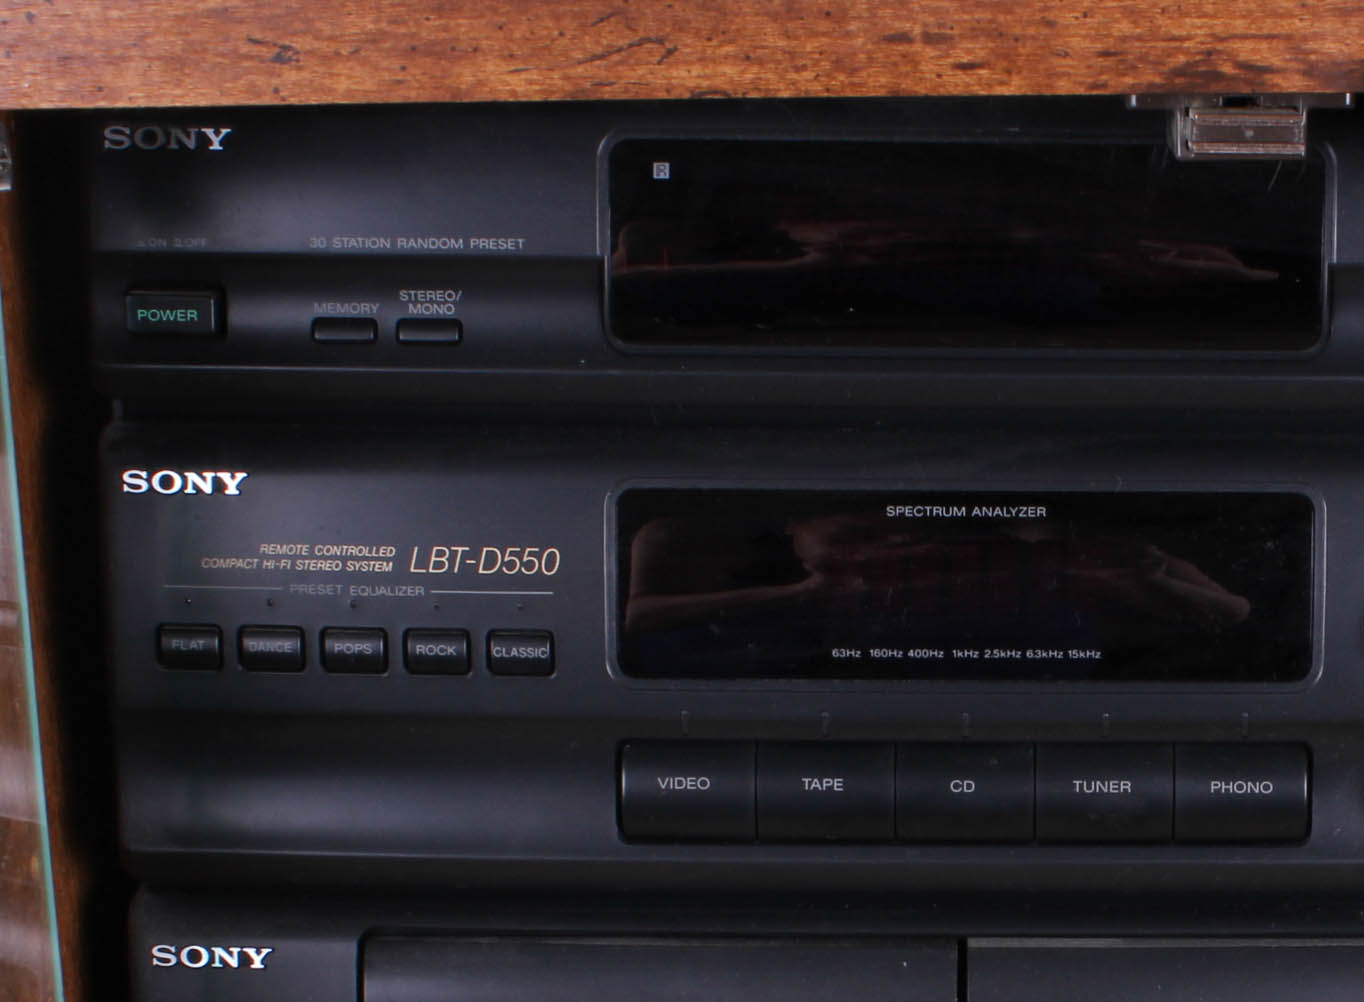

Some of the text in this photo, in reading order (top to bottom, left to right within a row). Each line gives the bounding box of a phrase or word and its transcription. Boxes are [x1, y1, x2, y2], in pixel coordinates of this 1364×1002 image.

[105, 127, 231, 150] SONY
[310, 237, 524, 249] 30 STATION RANDOM PRESET
[400, 290, 462, 301] STEREO/
[314, 303, 379, 314] MEMORY
[409, 303, 455, 315] MONO
[138, 309, 197, 321] POWER
[123, 470, 247, 494] SONY
[887, 506, 1046, 517] SPECTRUM ANALYZER
[260, 544, 395, 557] REMOTE CONTROLLED
[202, 558, 392, 572] COMPACT HI-FI STEREO SYSTEM
[410, 547, 560, 575] LBT-D550
[290, 584, 424, 596] PRESET EQUALIZER
[249, 641, 292, 652] DANCE
[334, 643, 372, 654] POPS
[416, 645, 456, 655] ROCK
[493, 646, 548, 658] CLASSIC
[832, 649, 861, 657] 63Hz
[870, 649, 903, 657] 160Hz
[908, 649, 944, 658] 400Hz
[953, 650, 979, 658] 1kHz
[984, 649, 1021, 658] 2.5kHz
[1068, 650, 1101, 658] 15kHz
[658, 777, 710, 790] VIDEO
[802, 778, 843, 791] TAPE
[950, 780, 975, 792] CD
[1073, 781, 1131, 793] TUNER
[1211, 781, 1273, 793] PHONO
[152, 945, 272, 968] SONY
